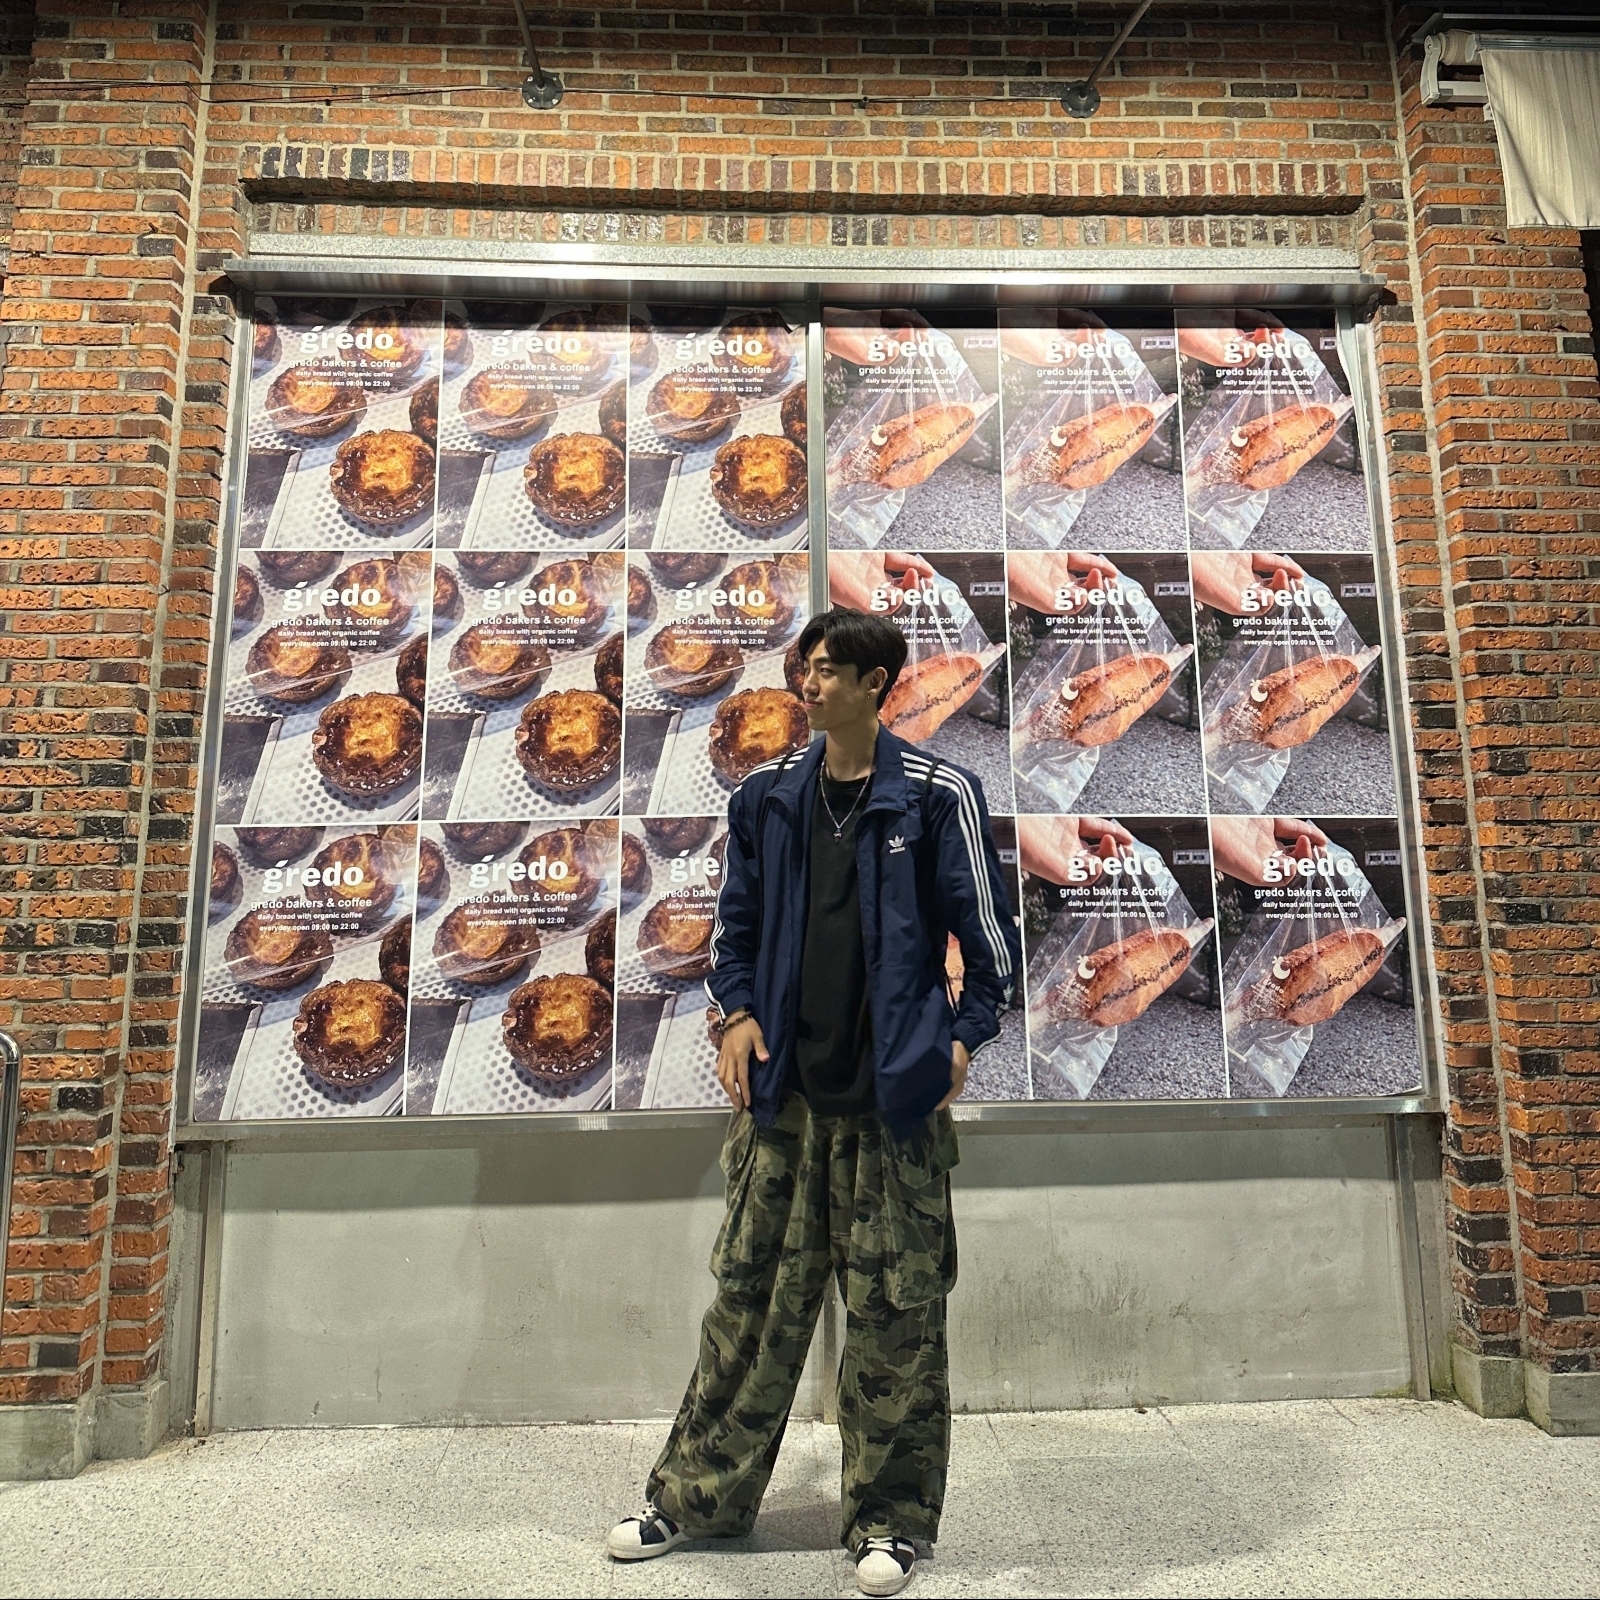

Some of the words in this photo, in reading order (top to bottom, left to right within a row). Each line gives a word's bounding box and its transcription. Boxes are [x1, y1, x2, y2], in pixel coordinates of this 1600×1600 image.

[299, 323, 395, 352] gredo
[491, 328, 582, 356] gredo
[675, 331, 762, 359] gredo
[867, 332, 954, 360] gredo
[1045, 335, 1131, 363] gredo
[1223, 335, 1310, 363] gredo
[289, 357, 319, 368] gredo
[322, 357, 357, 367] bakers
[360, 357, 368, 366] &
[370, 357, 403, 367] coffee
[481, 360, 511, 372] gredo
[513, 361, 547, 371] bakers
[549, 362, 557, 371] &
[559, 362, 591, 372] coffee
[666, 364, 695, 375] gredo
[697, 364, 730, 374] bakers
[731, 365, 739, 373] &
[741, 364, 772, 374] coffee
[889, 365, 922, 374] bakers
[1067, 367, 1099, 375] bakers
[1246, 367, 1279, 376] bakers
[282, 581, 381, 612] gredo
[482, 581, 577, 611] gredo
[675, 582, 766, 611] gredo
[870, 582, 959, 611] gredo
[1055, 581, 1145, 610] gredo
[1241, 582, 1330, 611] gredo
[271, 617, 303, 628] gredo
[306, 617, 342, 627] bakers
[345, 616, 353, 626] &
[356, 616, 390, 626] coffee
[472, 616, 502, 627] gredo
[505, 616, 540, 626] bakers
[543, 616, 551, 625] &
[553, 616, 586, 626] coffee
[665, 616, 695, 627] gredo
[697, 616, 732, 625] bakers
[734, 616, 742, 625] &
[744, 615, 775, 625] coffee
[892, 615, 926, 624] bakers
[1046, 615, 1076, 626] gredo
[1078, 615, 1112, 624] bakers
[1233, 616, 1262, 627] gredo
[1265, 617, 1298, 625] bakers
[332, 630, 358, 638] organic
[531, 629, 556, 637] organic
[670, 849, 720, 883] gre
[1069, 848, 1163, 881] gredo
[1262, 850, 1355, 882] gredo
[262, 860, 364, 894] gredo
[468, 855, 569, 889] gredo
[457, 894, 489, 906] gredo
[492, 893, 530, 903] bakers
[532, 892, 541, 902] &
[543, 891, 578, 902] coffee
[660, 889, 690, 900] gredo
[693, 888, 719, 898] bake
[1060, 886, 1091, 898] gredo
[1093, 886, 1129, 896] bakers
[1254, 888, 1285, 899] gredo
[1287, 888, 1322, 897] bakers
[250, 899, 283, 911] gredo
[286, 899, 323, 909] bakers
[326, 898, 335, 908] &
[338, 897, 373, 907] coffee
[313, 912, 339, 920] organic
[519, 907, 545, 915] organic
